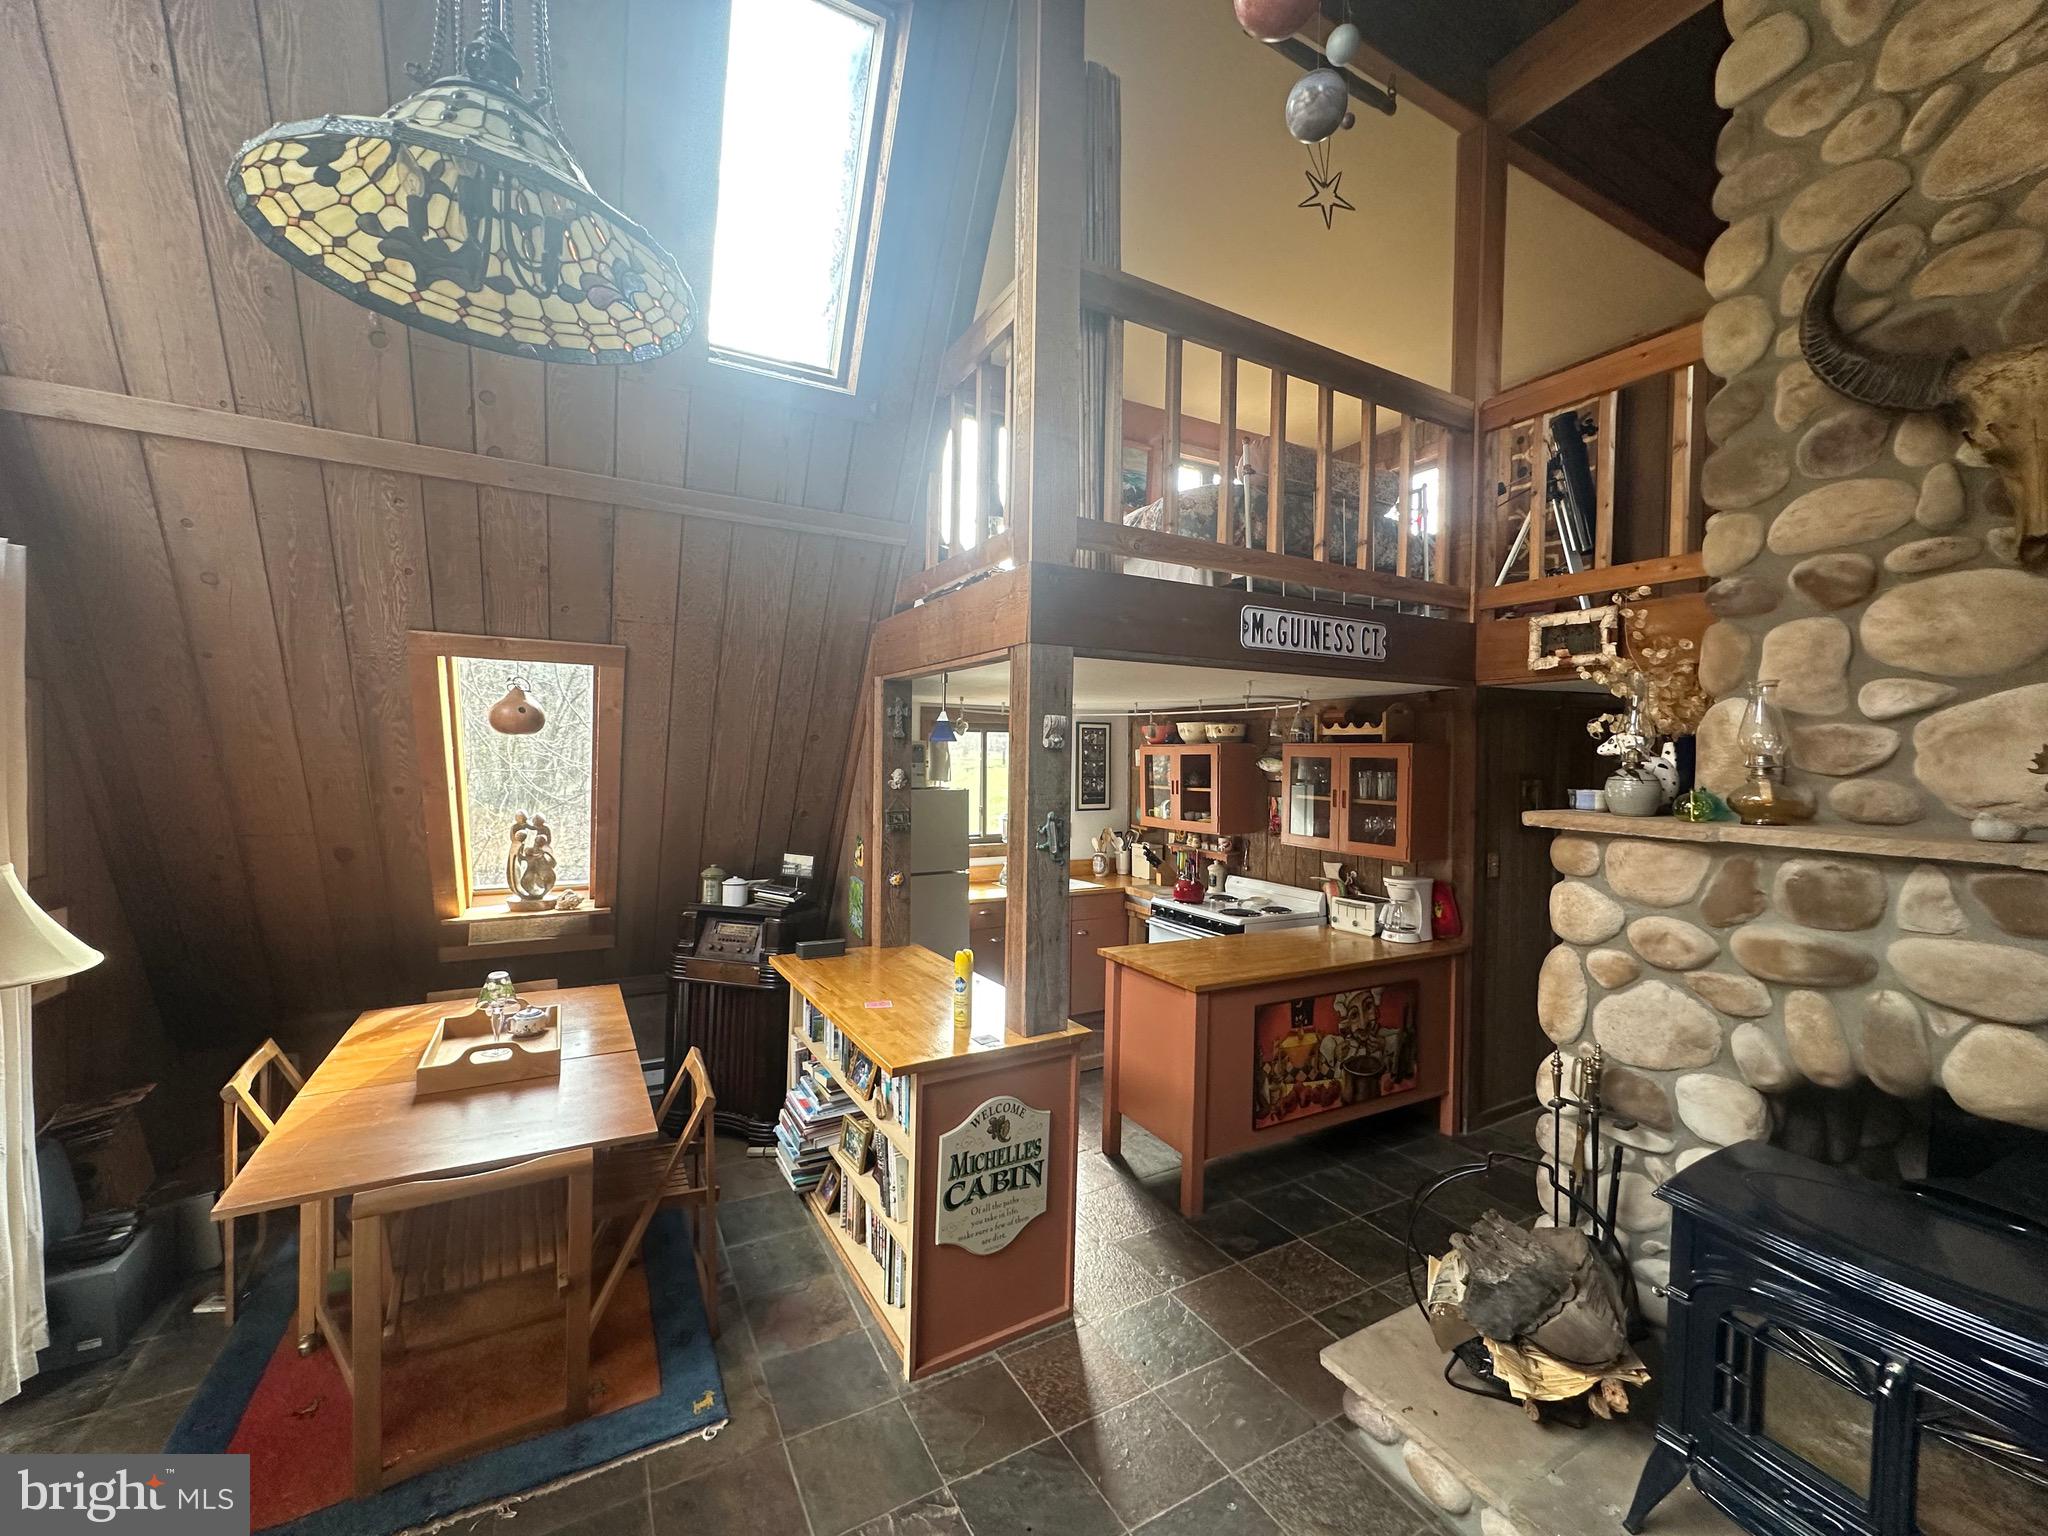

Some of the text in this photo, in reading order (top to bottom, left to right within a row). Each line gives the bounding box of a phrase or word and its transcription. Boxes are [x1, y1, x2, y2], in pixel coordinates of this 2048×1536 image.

[1251, 612, 1381, 657] McGUINESS CT.
[970, 1102, 1028, 1129] WELCOME
[948, 1138, 1042, 1181] MICHELLE'S
[943, 1159, 1045, 1212] CABIN
[970, 1196, 1019, 1216] Of all the paths
[971, 1219, 983, 1228] you
[984, 1213, 998, 1223] take
[999, 1211, 1005, 1219] in
[958, 1232, 974, 1241] make
[975, 1228, 988, 1236] sure
[994, 1221, 1005, 1231] few
[1007, 1217, 1014, 1226] of
[1015, 1215, 1030, 1225] them
